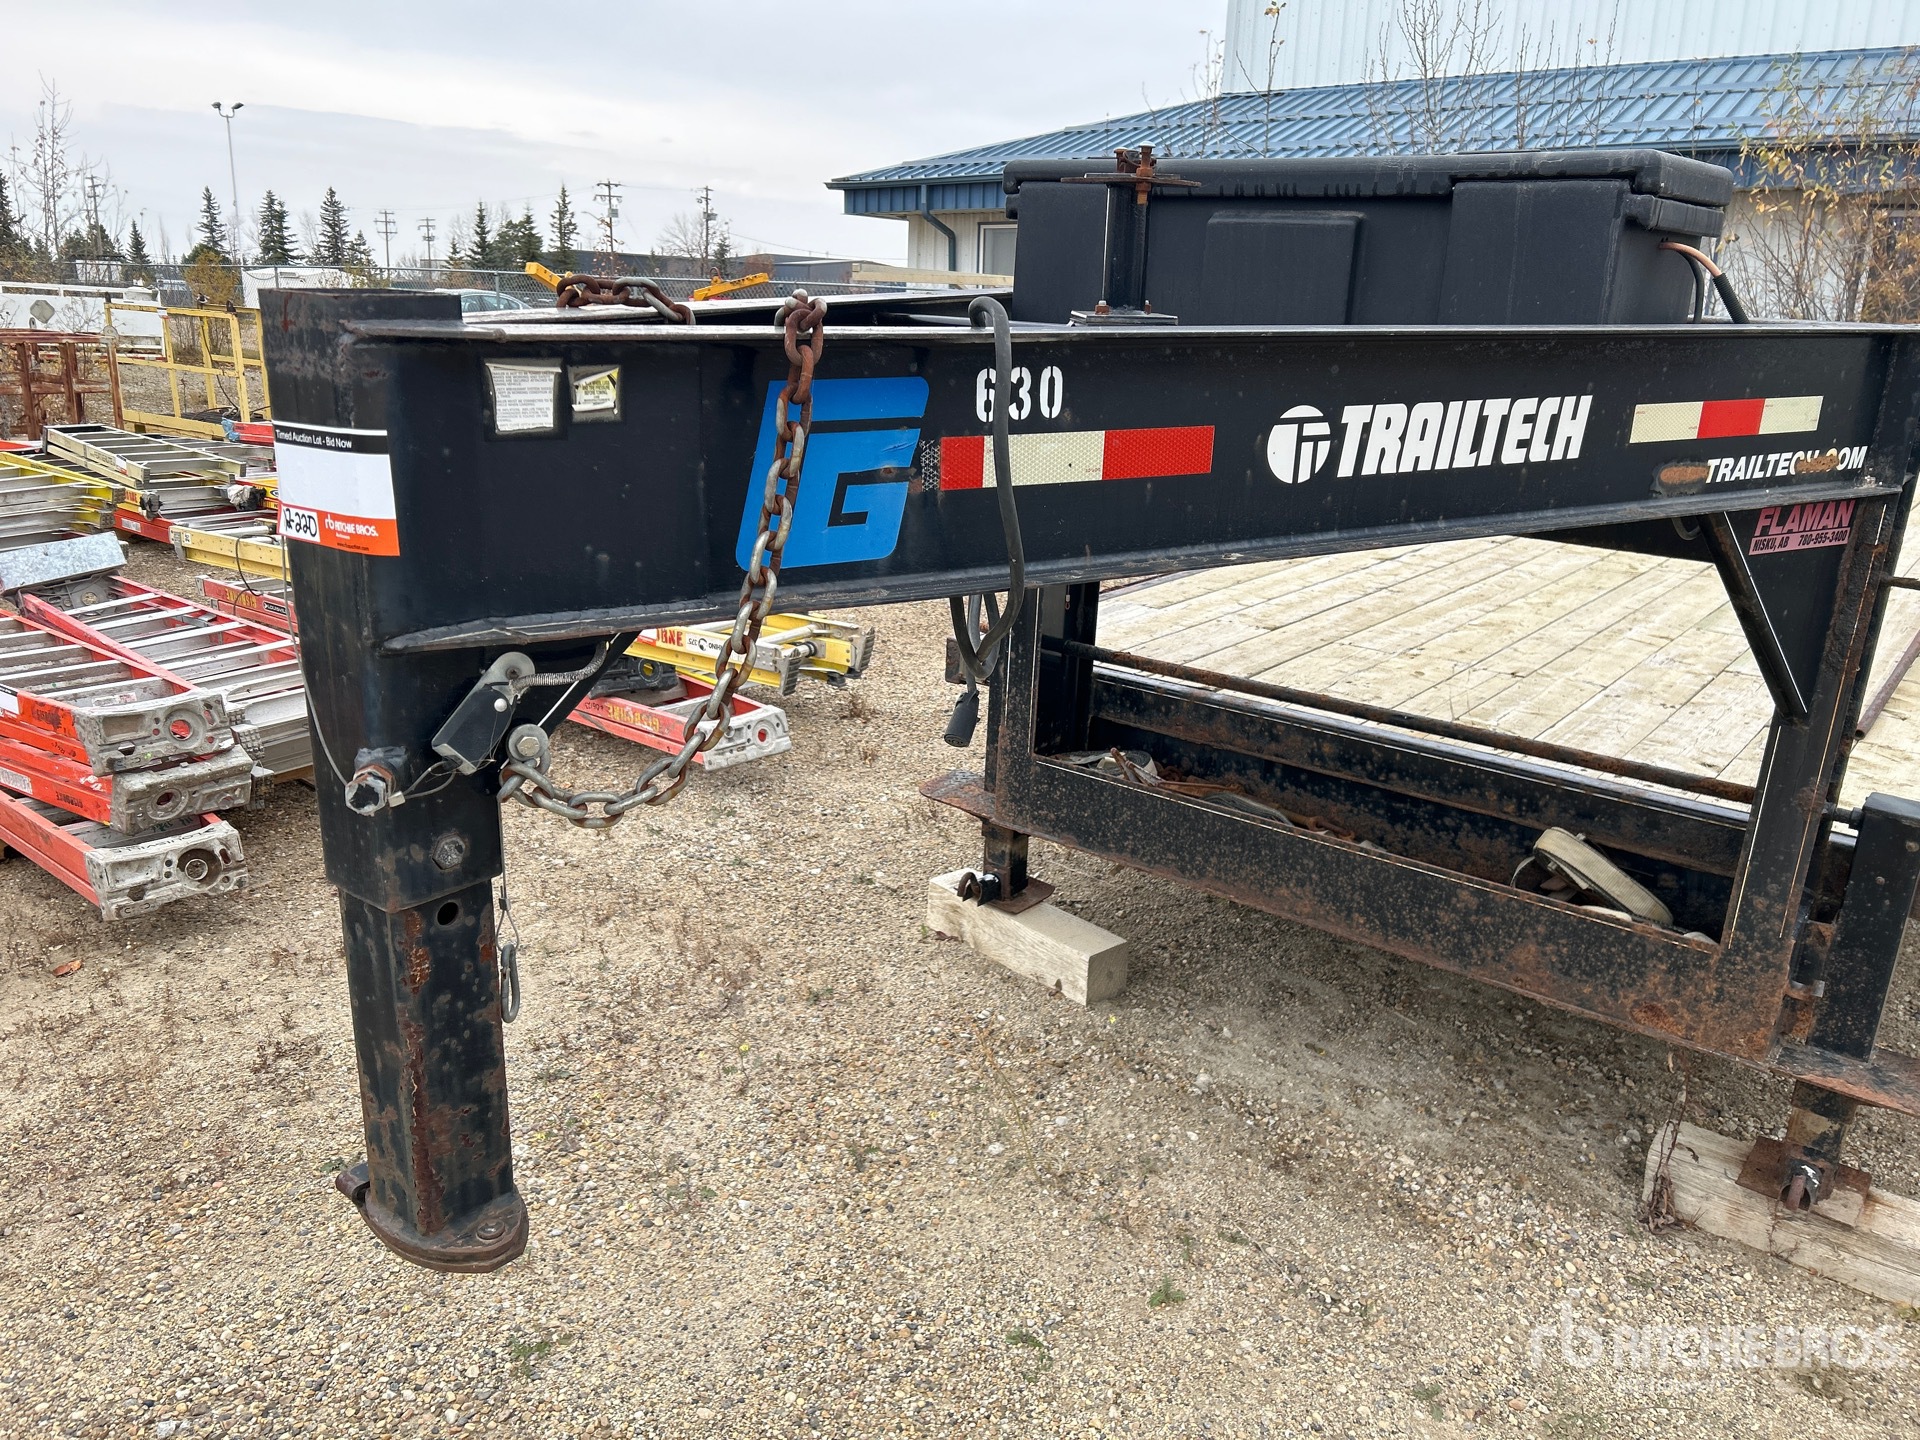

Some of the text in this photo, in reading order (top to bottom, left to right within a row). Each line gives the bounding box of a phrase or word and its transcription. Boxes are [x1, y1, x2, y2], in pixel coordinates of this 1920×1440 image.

[275, 429, 292, 441] Timed
[292, 432, 312, 444] Auction
[312, 434, 322, 445] Lot
[326, 436, 335, 447] Bid
[335, 438, 352, 449] Now
[1337, 395, 1593, 478] TRAILTECH
[335, 520, 356, 534] RITCHIE
[1754, 500, 1855, 537] FLAMAN
[1777, 536, 1789, 549] AB
[1798, 530, 1848, 546] 780-955-3400
